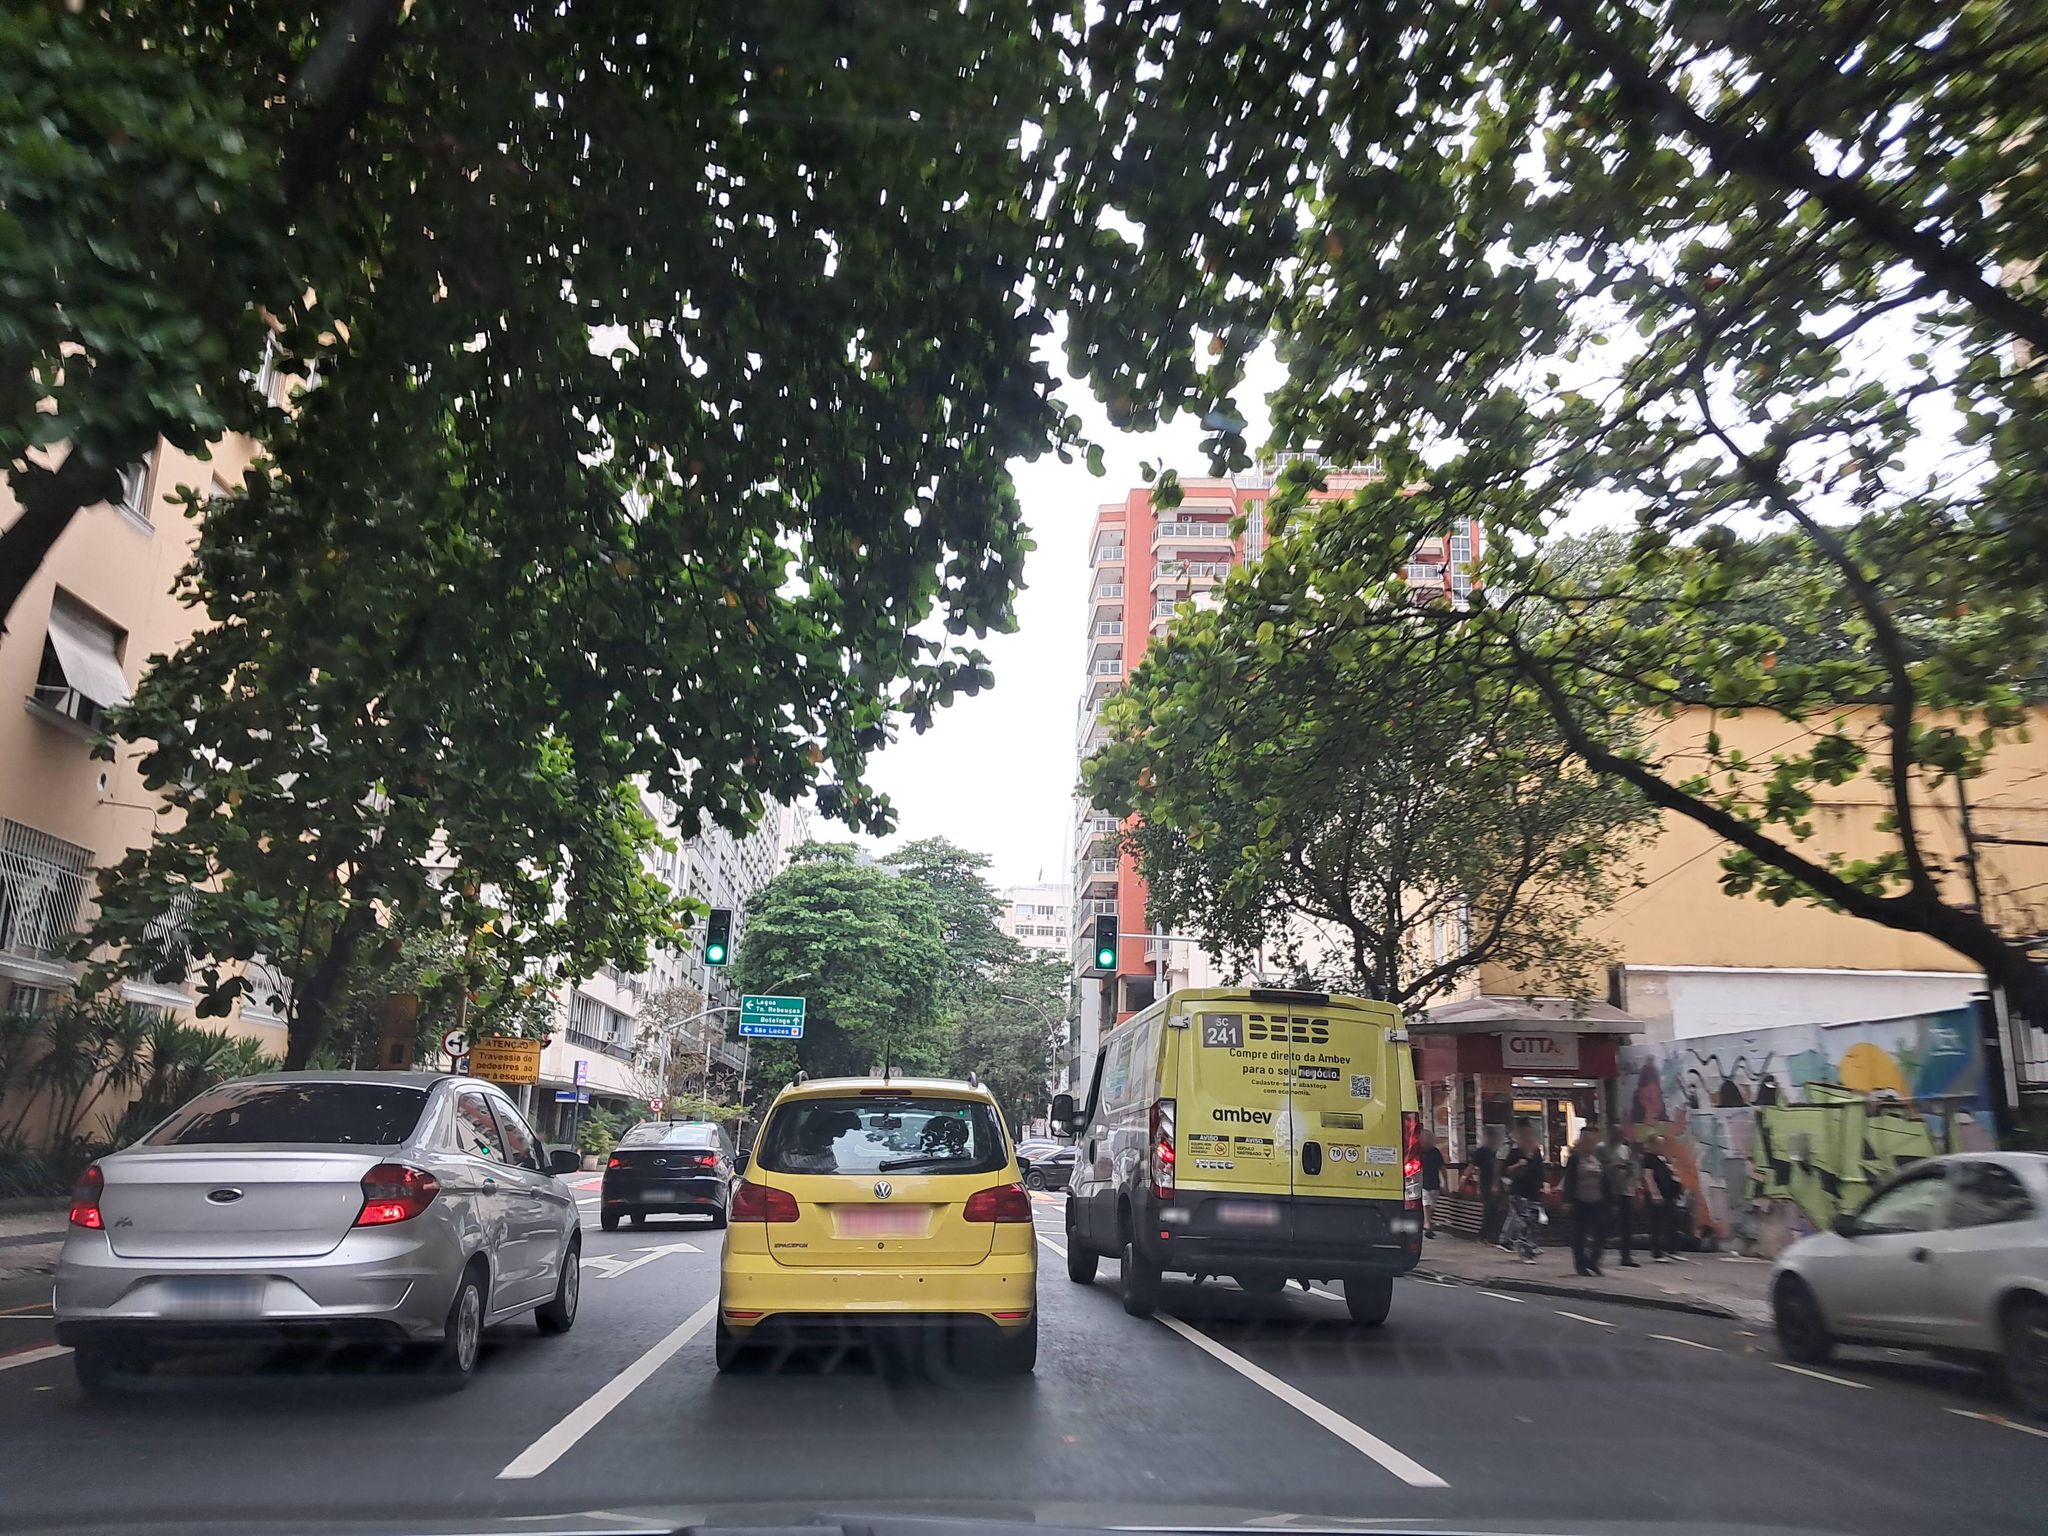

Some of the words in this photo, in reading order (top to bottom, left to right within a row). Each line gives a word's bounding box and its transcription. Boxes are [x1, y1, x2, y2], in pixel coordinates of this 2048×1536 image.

[1215, 1017, 1229, 1027] SC
[1249, 1015, 1329, 1044] BEES
[1207, 1027, 1238, 1044] 241
[479, 1052, 521, 1062] Travessia
[1229, 1048, 1268, 1060] Compre
[1270, 1050, 1301, 1061] direto
[1303, 1052, 1316, 1062] da
[1318, 1053, 1351, 1064] Ambev
[476, 1062, 519, 1071] pedestres
[523, 1064, 533, 1072] ao
[1242, 1064, 1266, 1075] para
[1268, 1067, 1274, 1075] o
[1277, 1067, 1297, 1076] seu
[499, 1073, 537, 1082] esquerda
[1212, 1107, 1272, 1125] ambev
[1332, 1149, 1341, 1157] 70
[1348, 1149, 1357, 1157] 56
